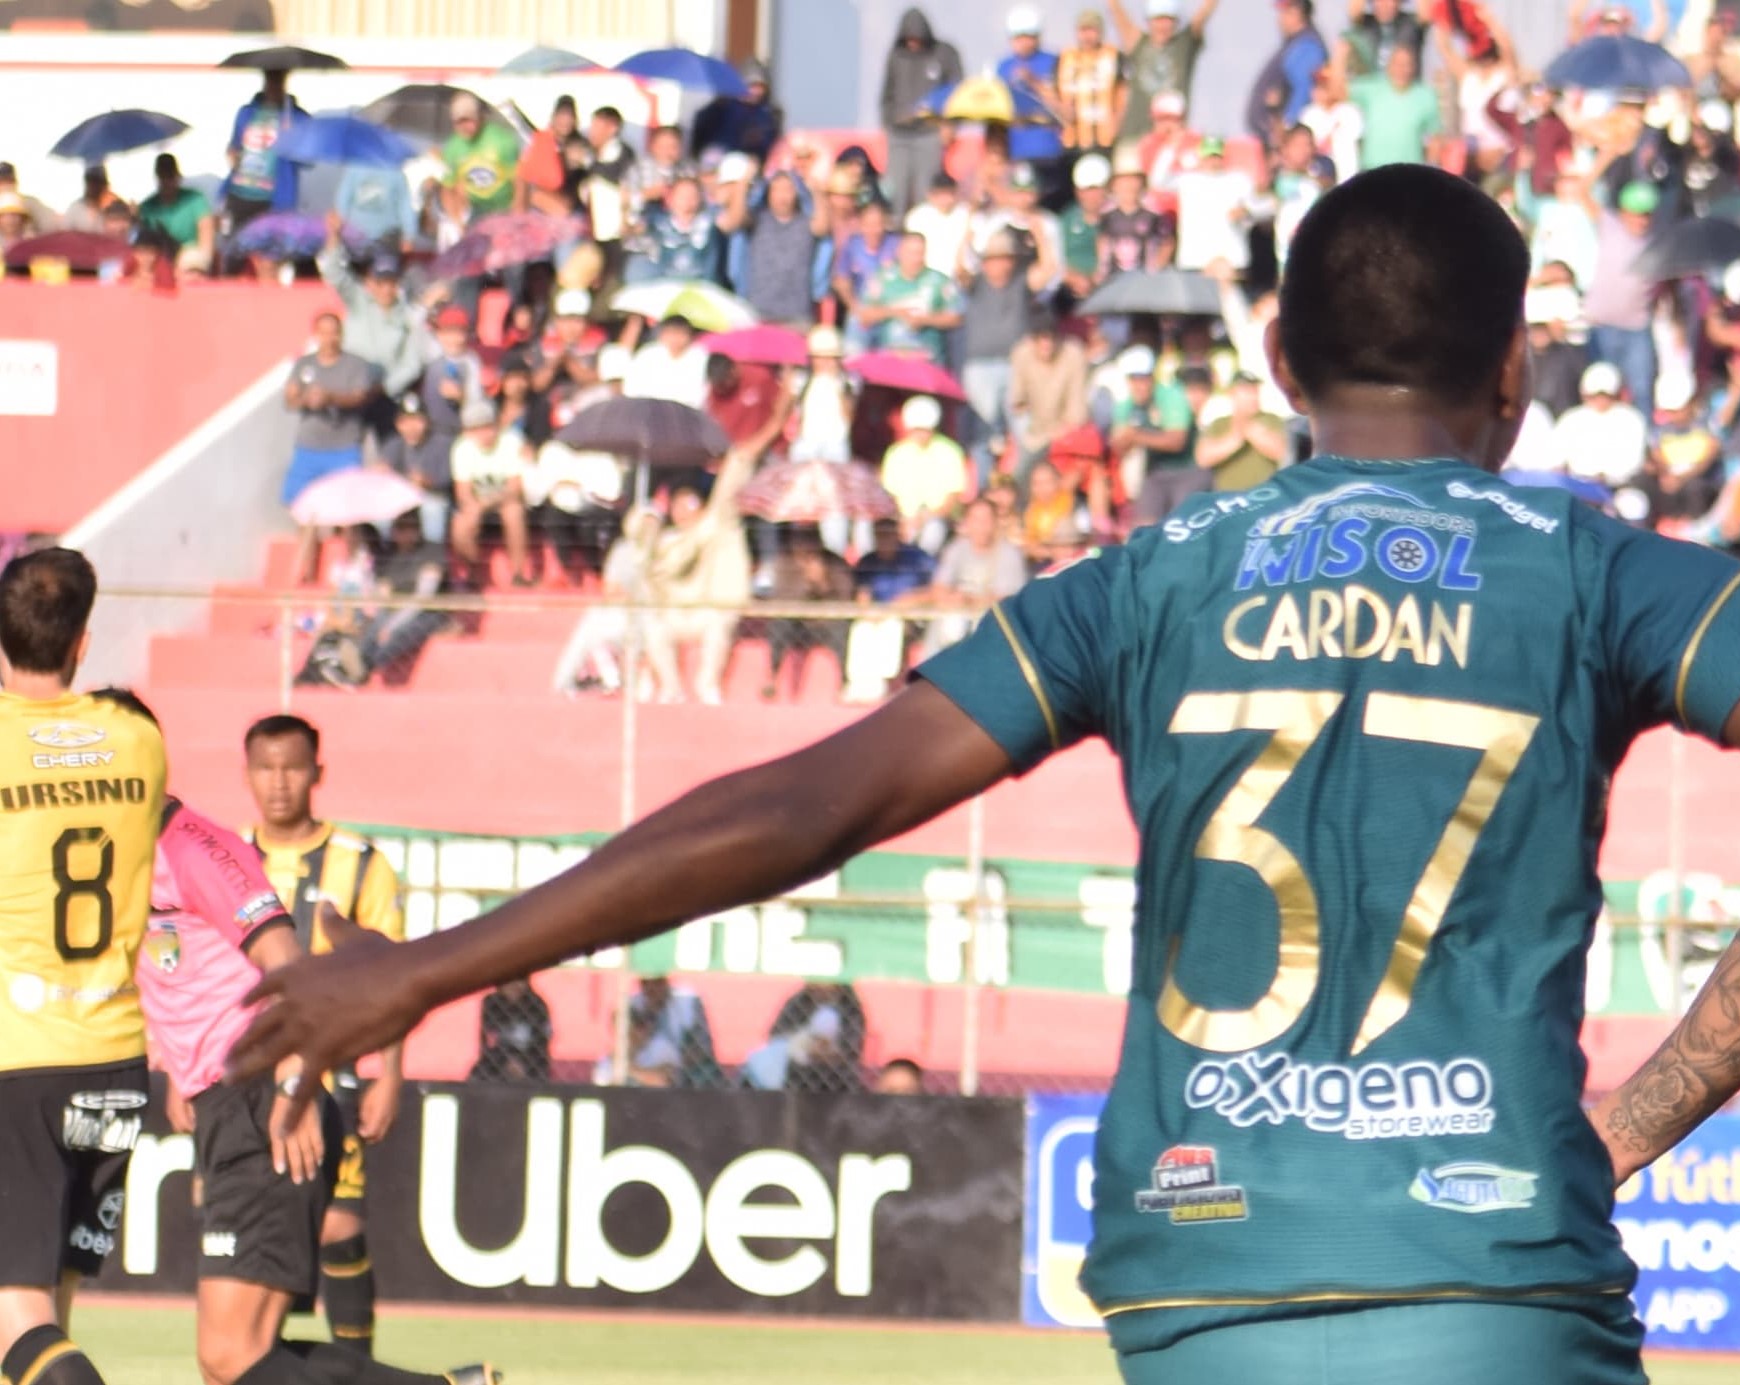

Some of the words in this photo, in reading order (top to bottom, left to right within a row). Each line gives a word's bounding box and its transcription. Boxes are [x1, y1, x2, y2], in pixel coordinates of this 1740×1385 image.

[1223, 584, 1473, 669] CARDAN
[0, 777, 147, 813] URSINO
[32, 750, 117, 769] CHERY
[50, 826, 115, 965] 8
[1156, 689, 1541, 1057] 37
[418, 1092, 913, 1298] Uber
[1643, 1285, 1731, 1335] APP
